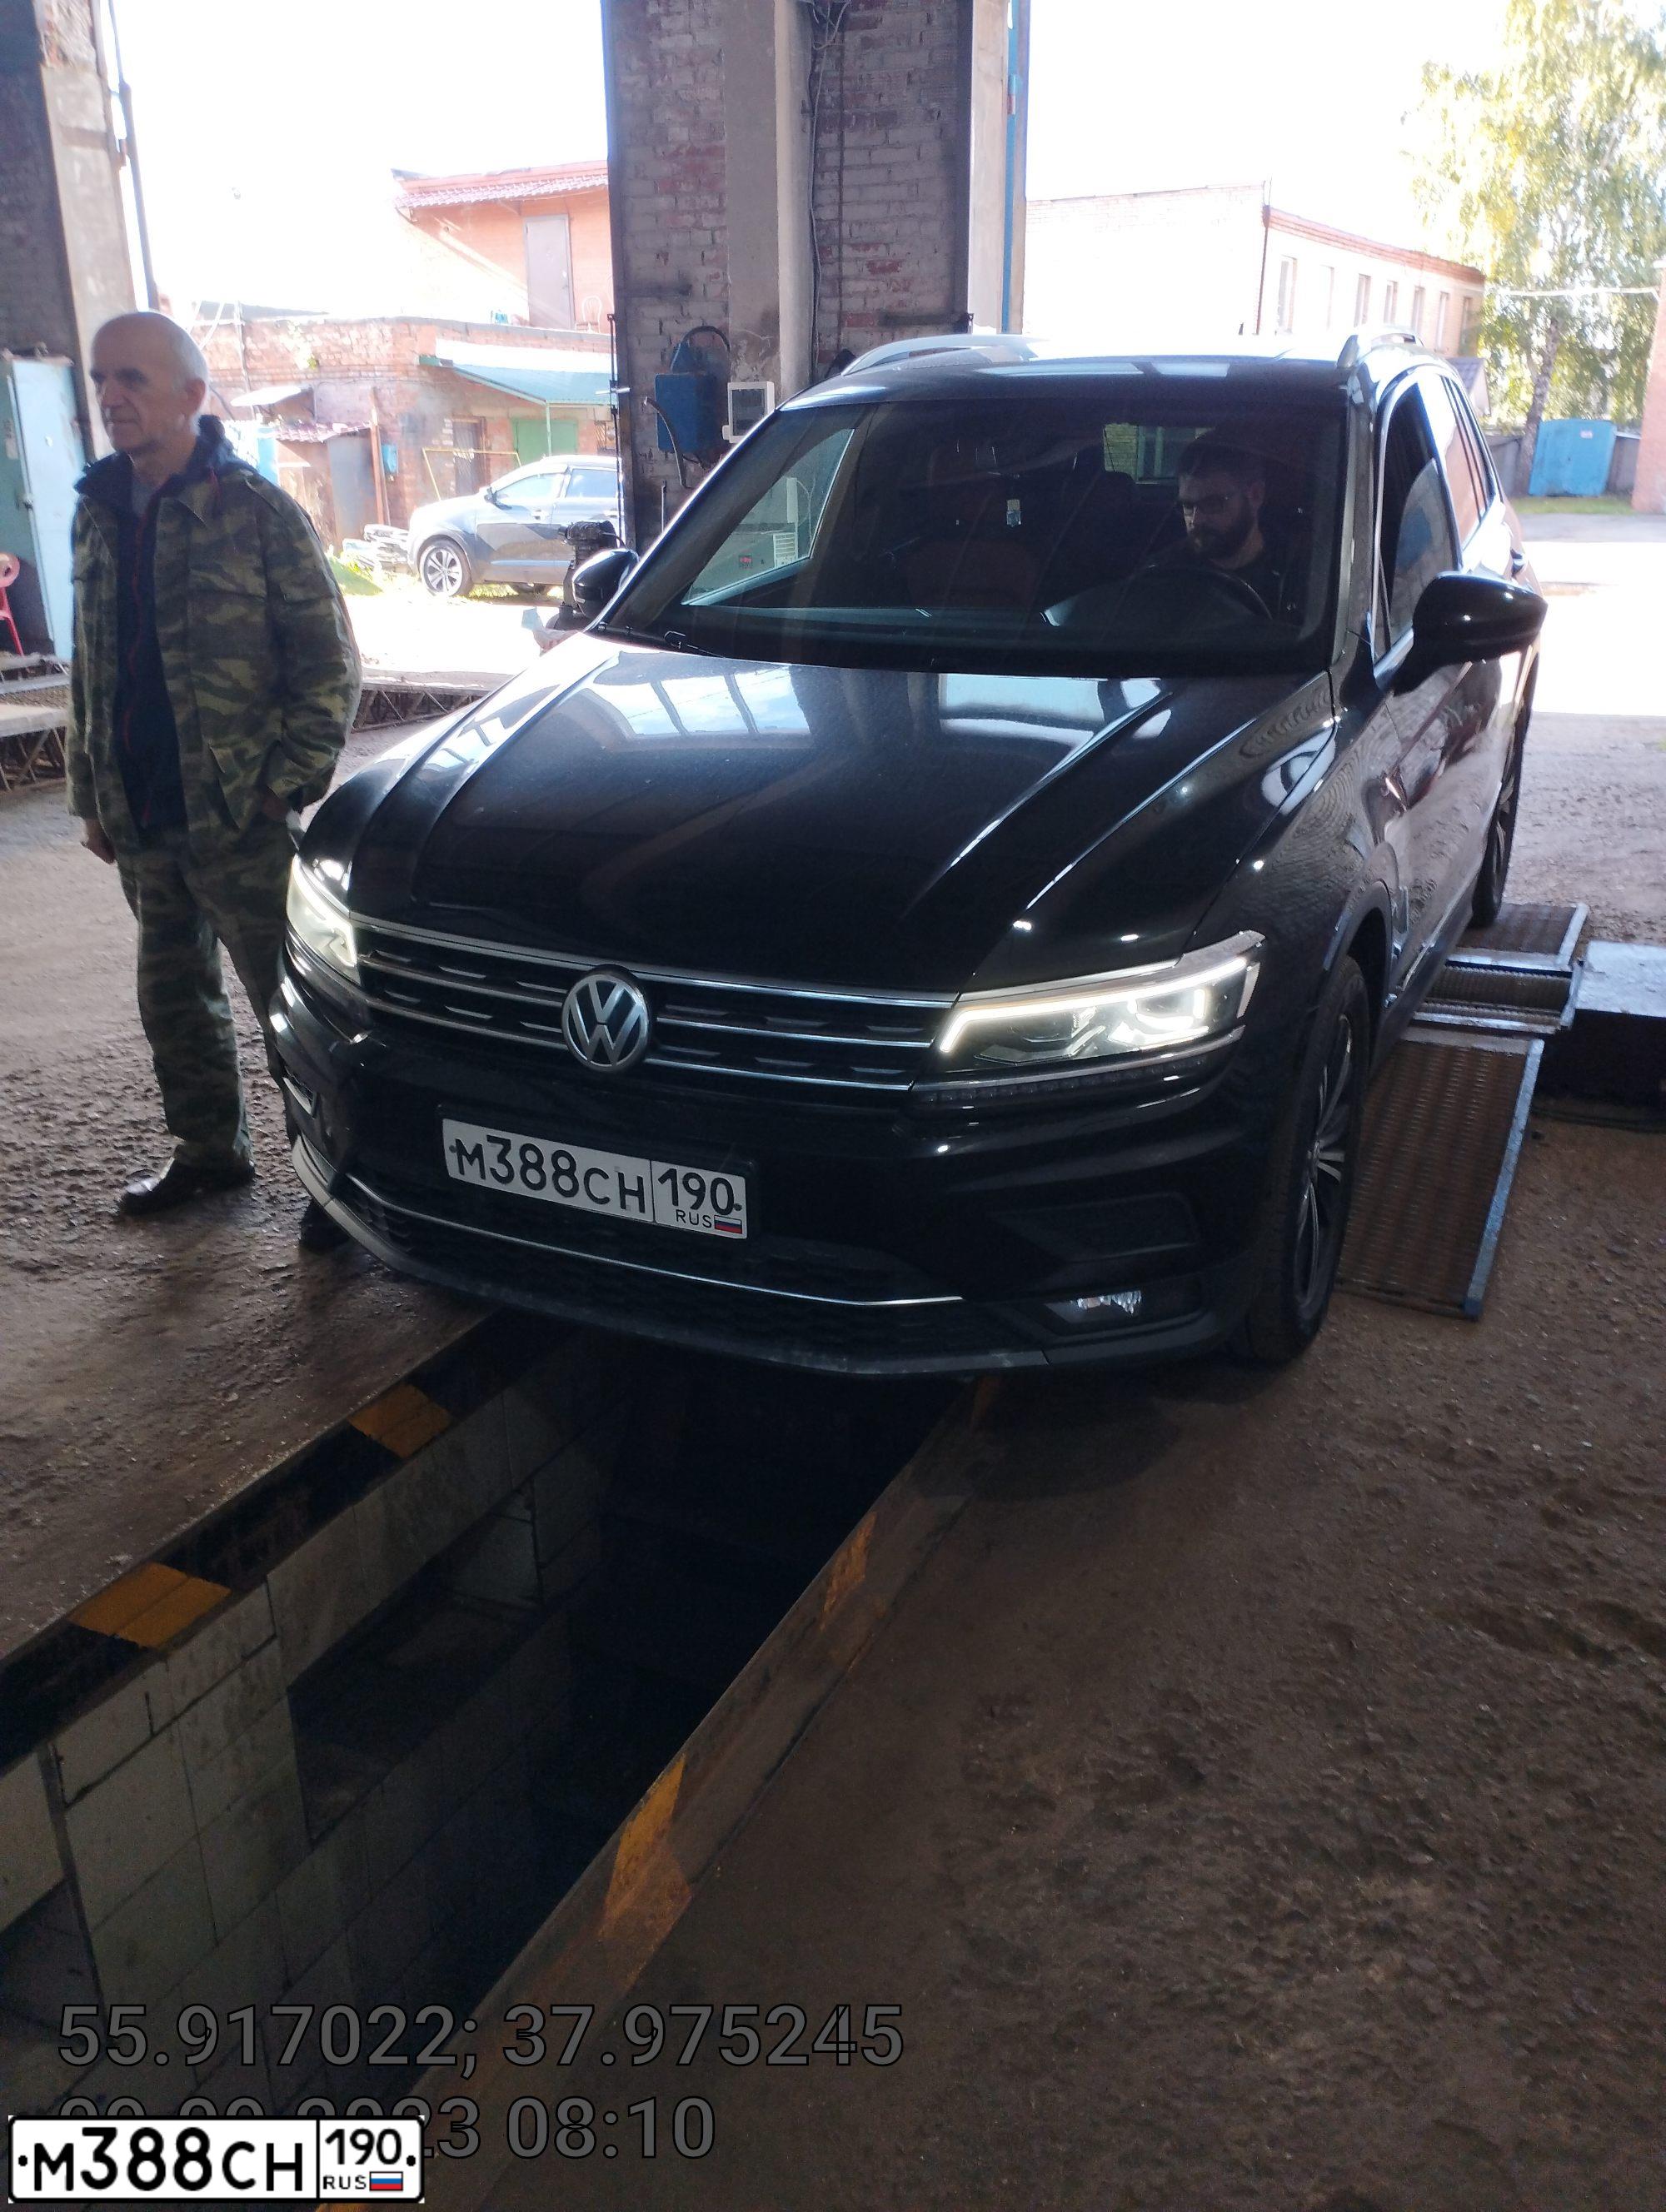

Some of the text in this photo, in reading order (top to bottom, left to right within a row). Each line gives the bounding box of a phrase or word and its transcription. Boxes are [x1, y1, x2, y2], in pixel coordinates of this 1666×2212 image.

[454, 1135, 735, 1215] М388СН 190
[676, 1208, 712, 1228] RUS
